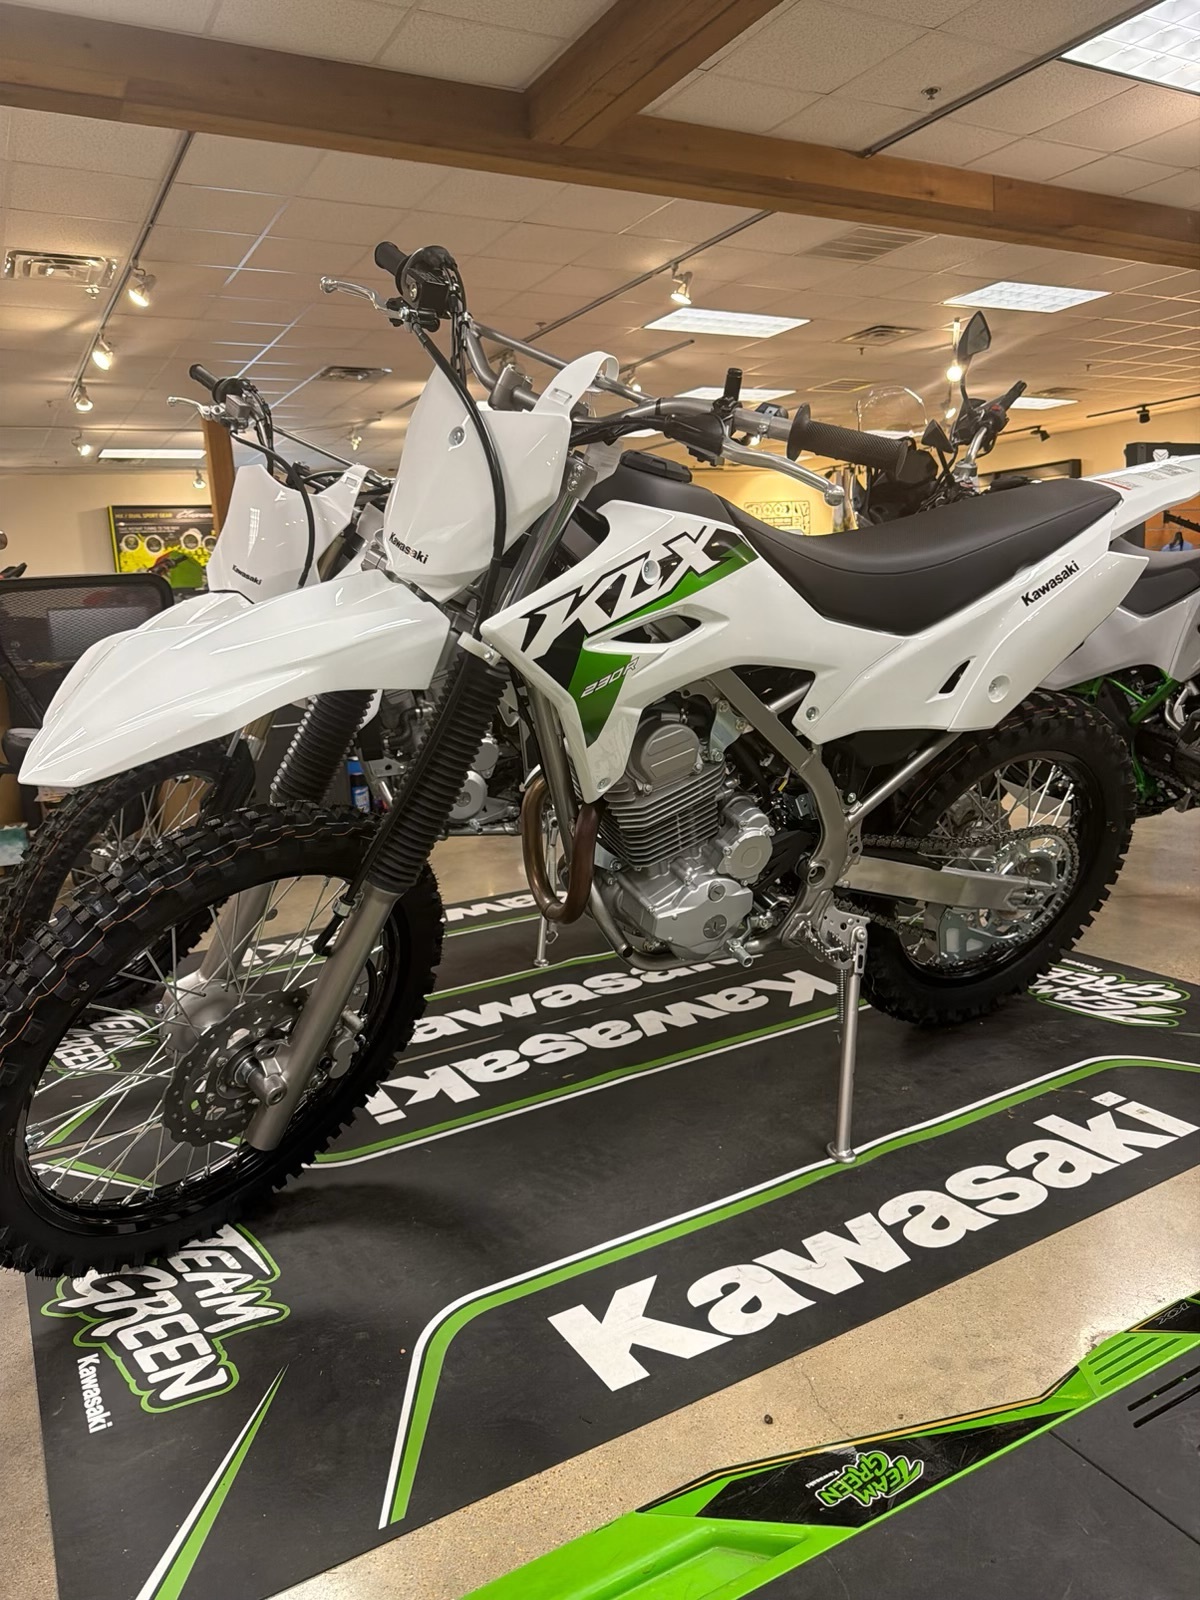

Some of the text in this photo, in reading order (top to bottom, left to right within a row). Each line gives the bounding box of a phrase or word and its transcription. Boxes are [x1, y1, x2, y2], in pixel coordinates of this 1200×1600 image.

[389, 531, 429, 565] Kawasaki
[232, 564, 263, 586] Kawasaki
[1021, 560, 1080, 607] Kawasaki
[580, 656, 640, 699] 230R
[364, 969, 839, 1125] Kawasaki
[547, 1091, 1200, 1392] Kawasaki
[58, 1264, 229, 1401] GREEN
[77, 1353, 114, 1434] Kawasaki
[819, 1451, 889, 1505] GREEN
[853, 1457, 921, 1505] TEAM
